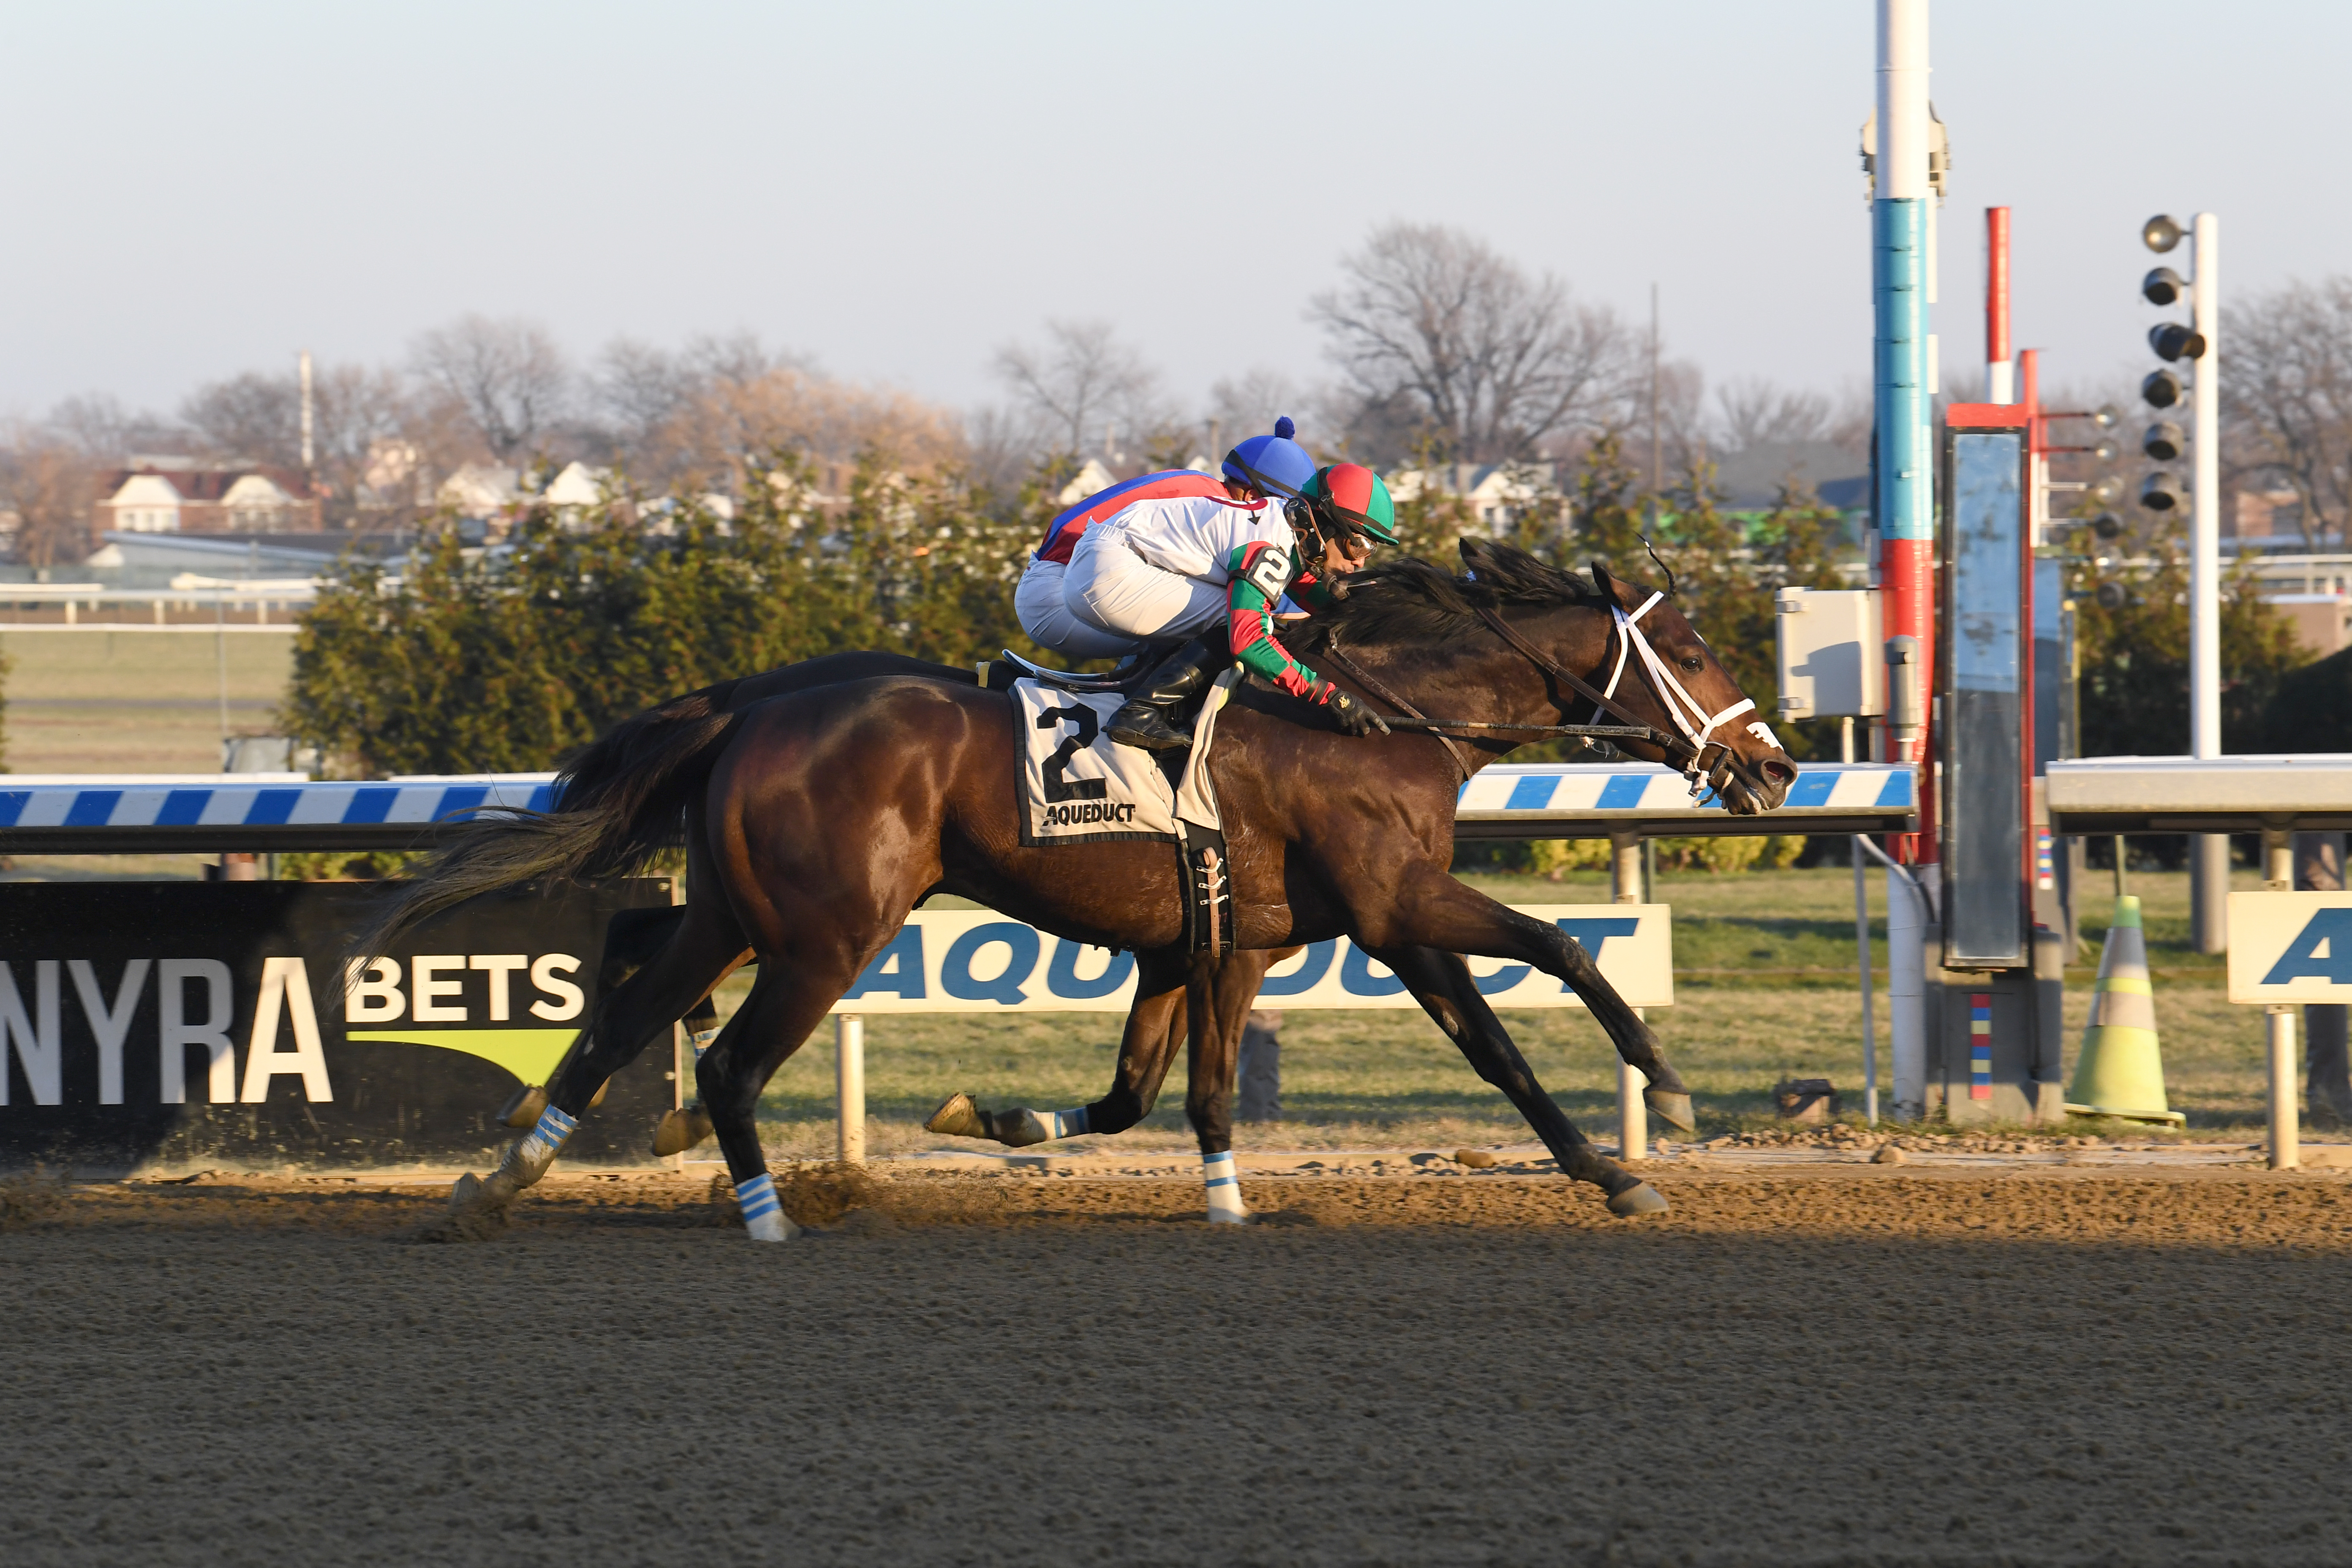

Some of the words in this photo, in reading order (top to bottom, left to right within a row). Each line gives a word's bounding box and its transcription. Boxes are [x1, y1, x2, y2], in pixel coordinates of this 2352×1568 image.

[1253, 550, 1291, 596] 2
[1037, 703, 1107, 803] 2
[1043, 803, 1135, 826] AQUEDUCT
[0, 957, 333, 1106] NYRA
[346, 953, 585, 1023] BETS
